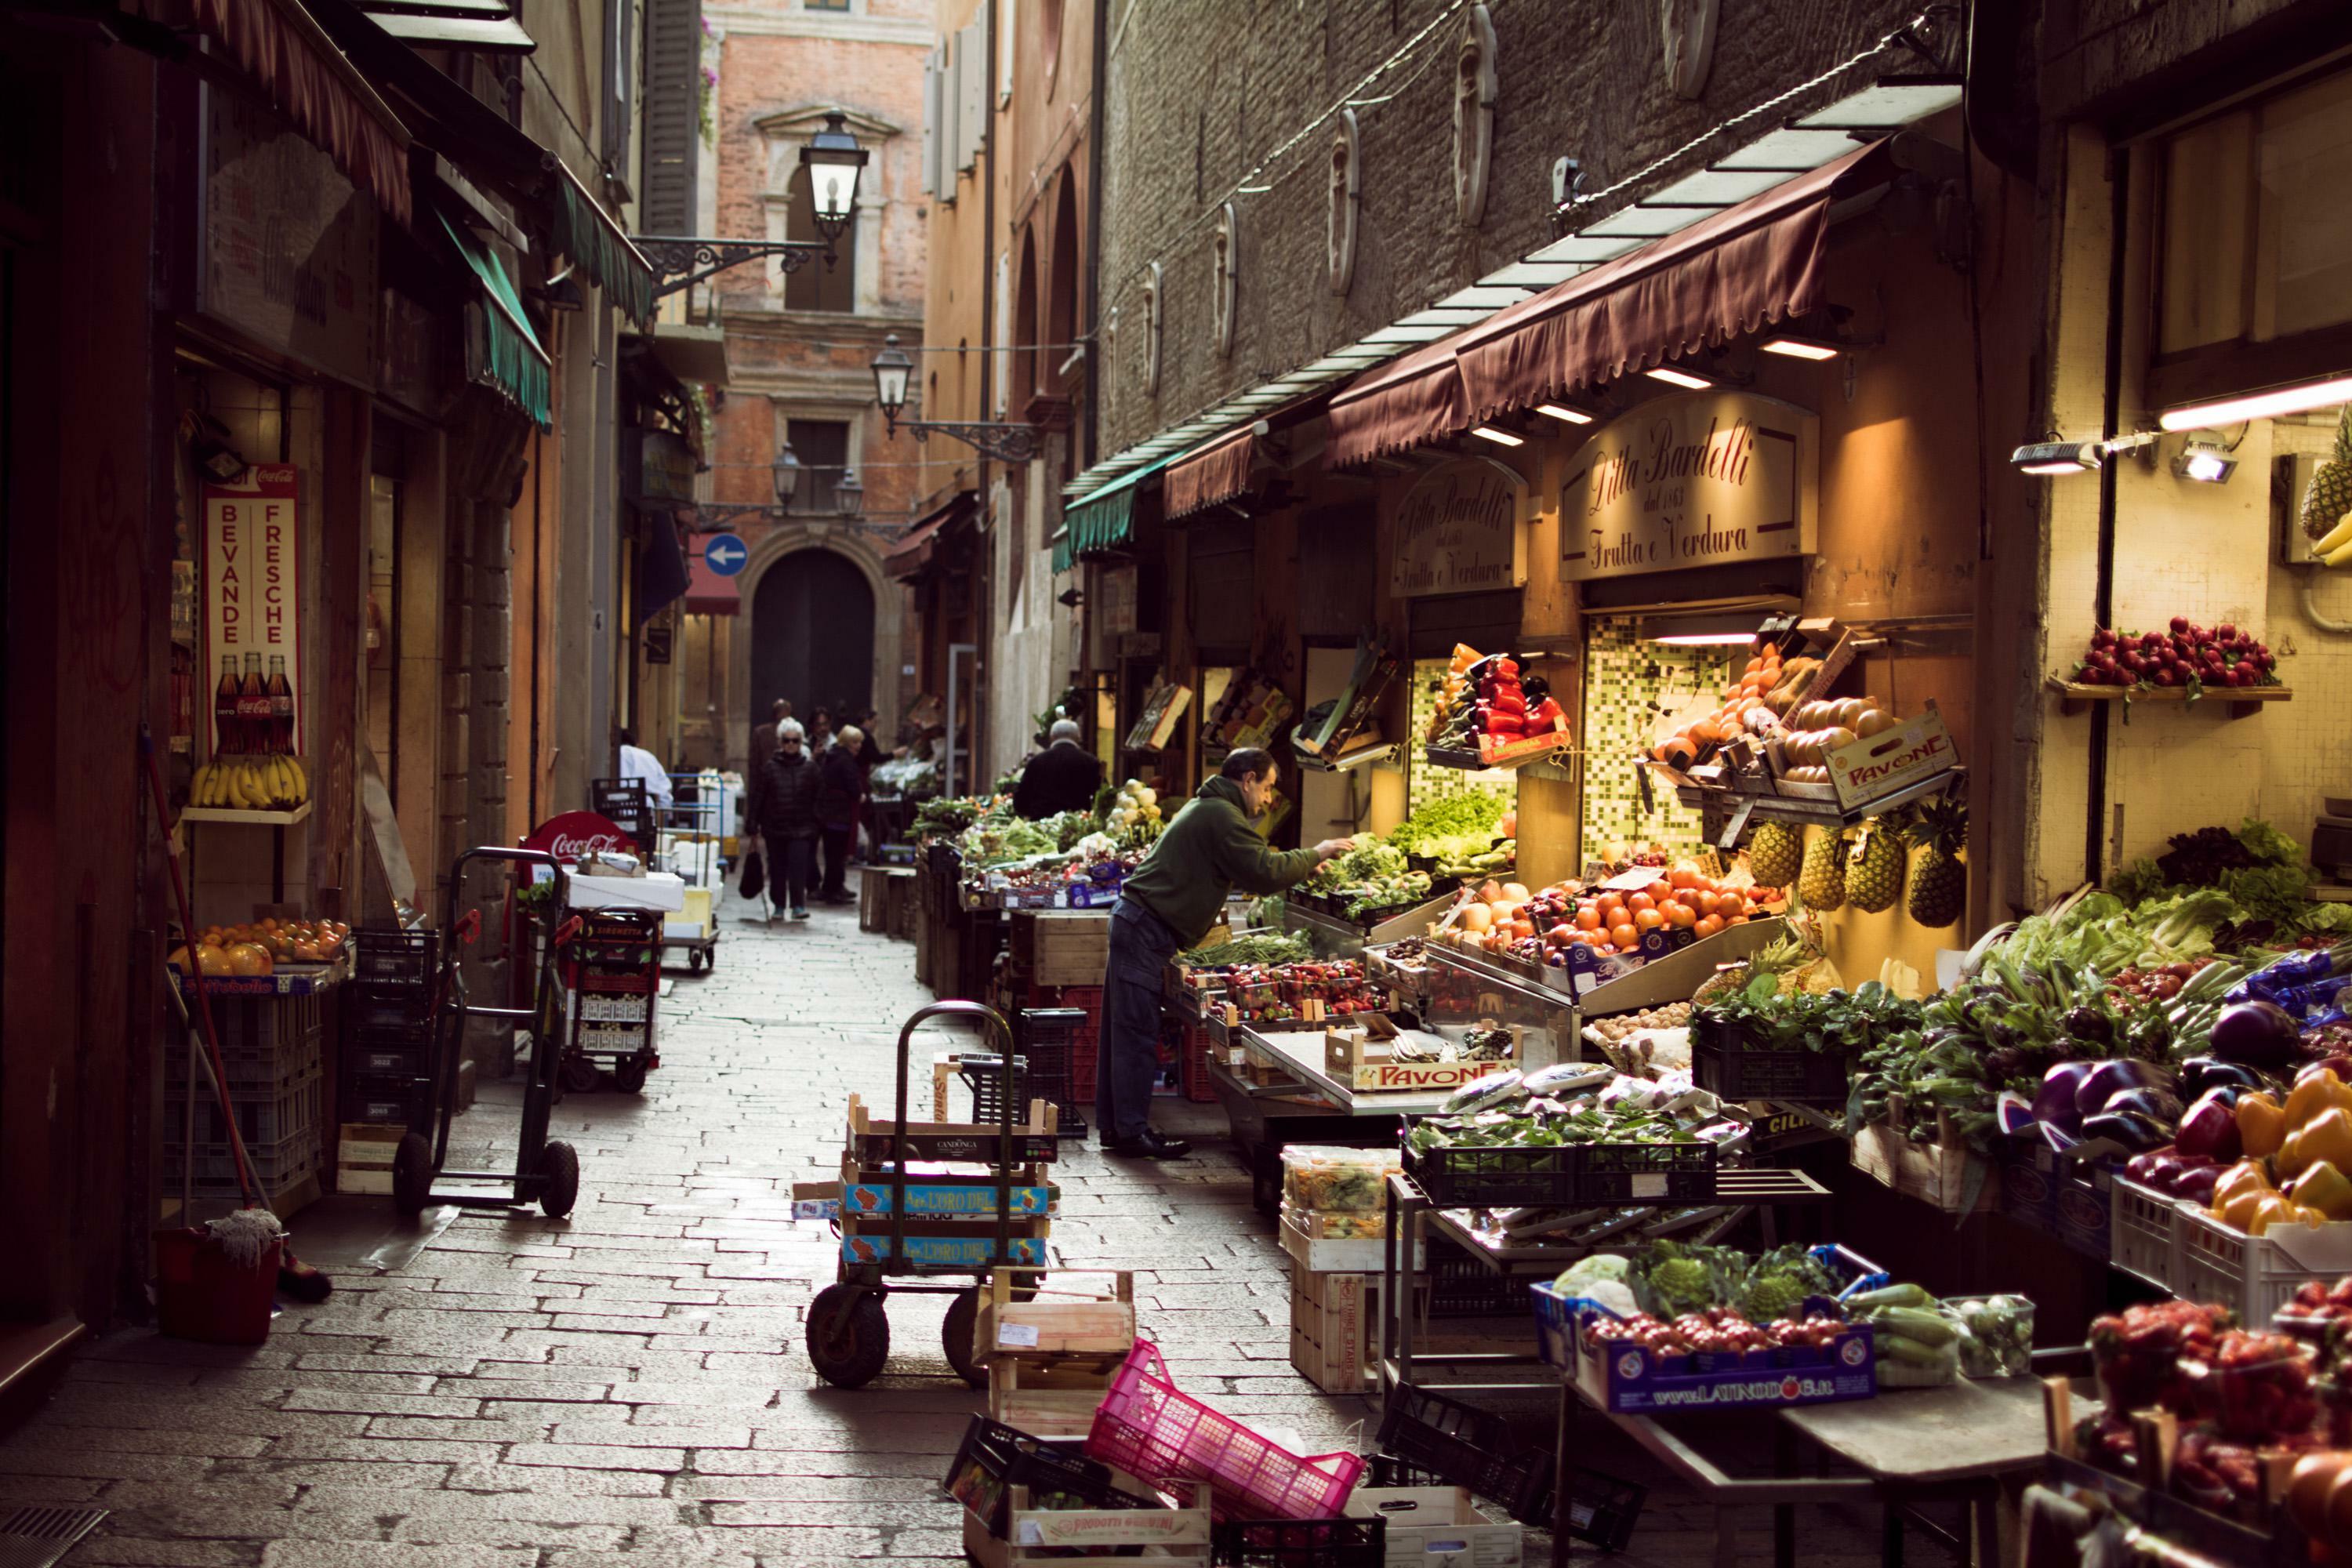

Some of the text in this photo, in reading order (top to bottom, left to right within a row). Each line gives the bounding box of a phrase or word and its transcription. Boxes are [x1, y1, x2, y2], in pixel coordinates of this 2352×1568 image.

[1645, 416, 1752, 486] Bardelli
[1438, 474, 1506, 531] Bardelli
[1644, 486, 1661, 513] dal
[1589, 514, 1748, 569] Frutta e Verdura
[221, 505, 238, 644] BEVANDE
[265, 505, 282, 644] FRESCHE
[1849, 735, 1948, 786] PAVONE
[1380, 1063, 1498, 1085] PAVONE
